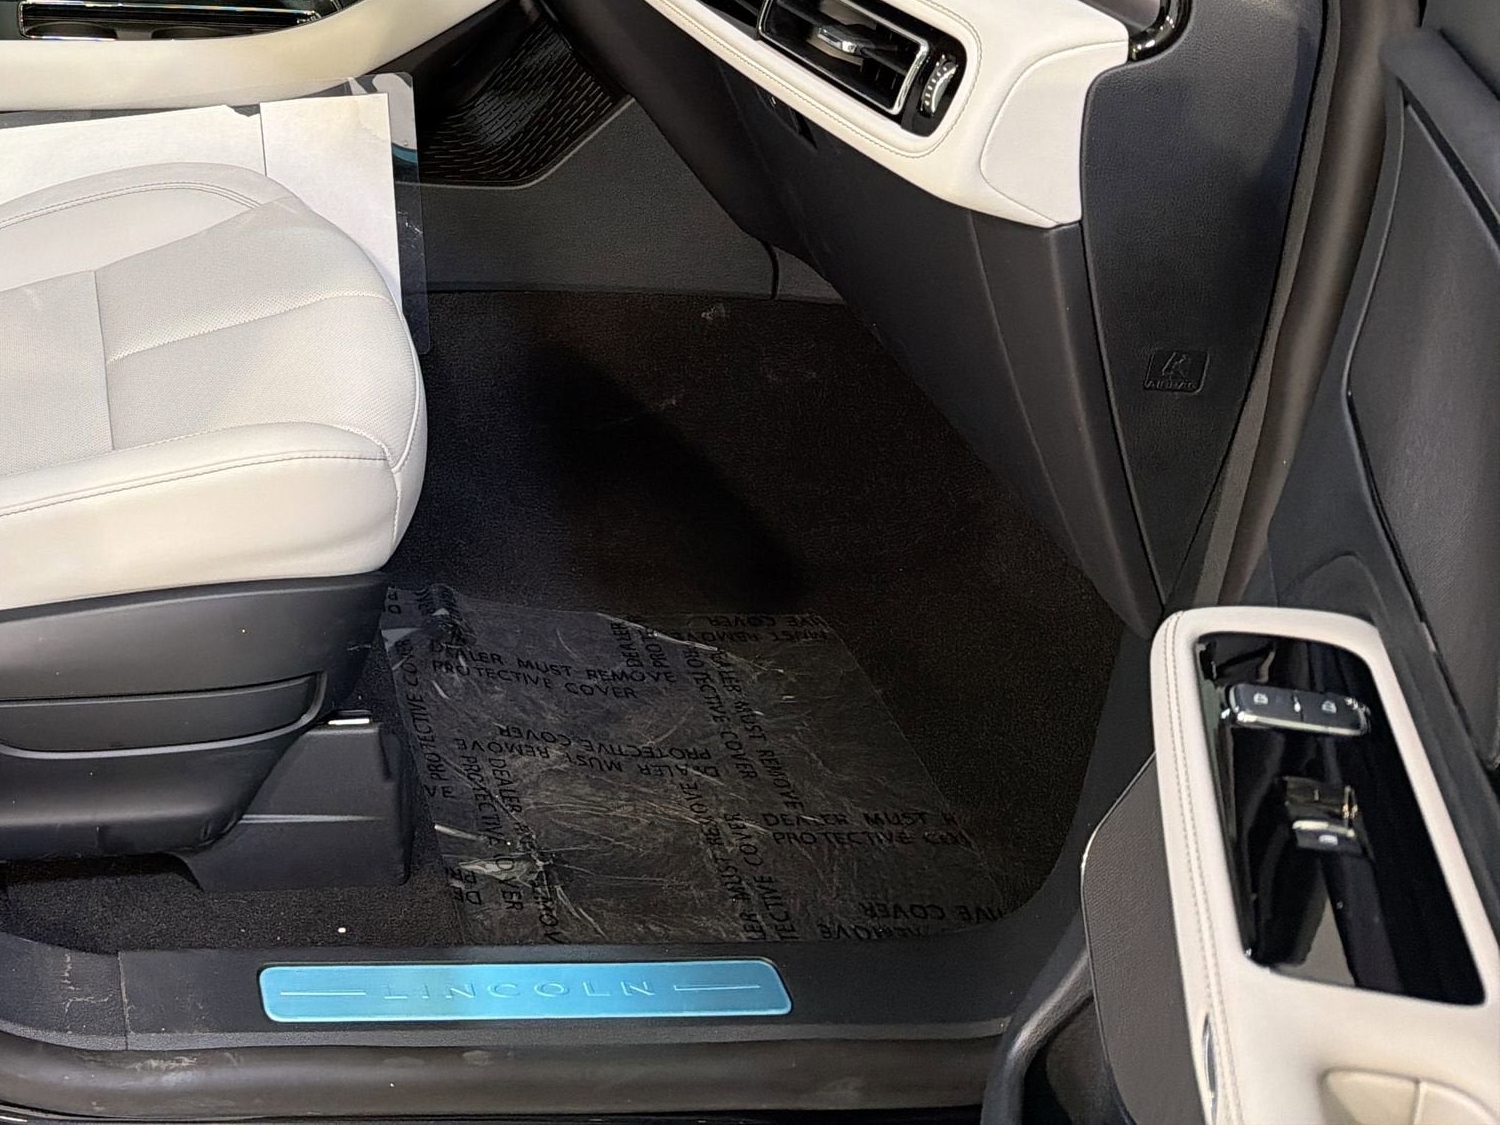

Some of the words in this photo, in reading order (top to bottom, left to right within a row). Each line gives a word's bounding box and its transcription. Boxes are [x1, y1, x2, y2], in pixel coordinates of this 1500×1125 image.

[432, 660, 553, 690] PROTECTIVE
[564, 681, 639, 699] COVER
[517, 657, 572, 677] MUST
[586, 667, 678, 684] REMOVE
[498, 725, 572, 748] COVER
[454, 737, 550, 760] REMOVE
[578, 737, 712, 762] PROTECTIVE
[562, 753, 623, 774] MUST
[753, 875, 800, 941] TECTIVE
[859, 903, 946, 921] COVER
[383, 978, 656, 1001] LINCOLN
